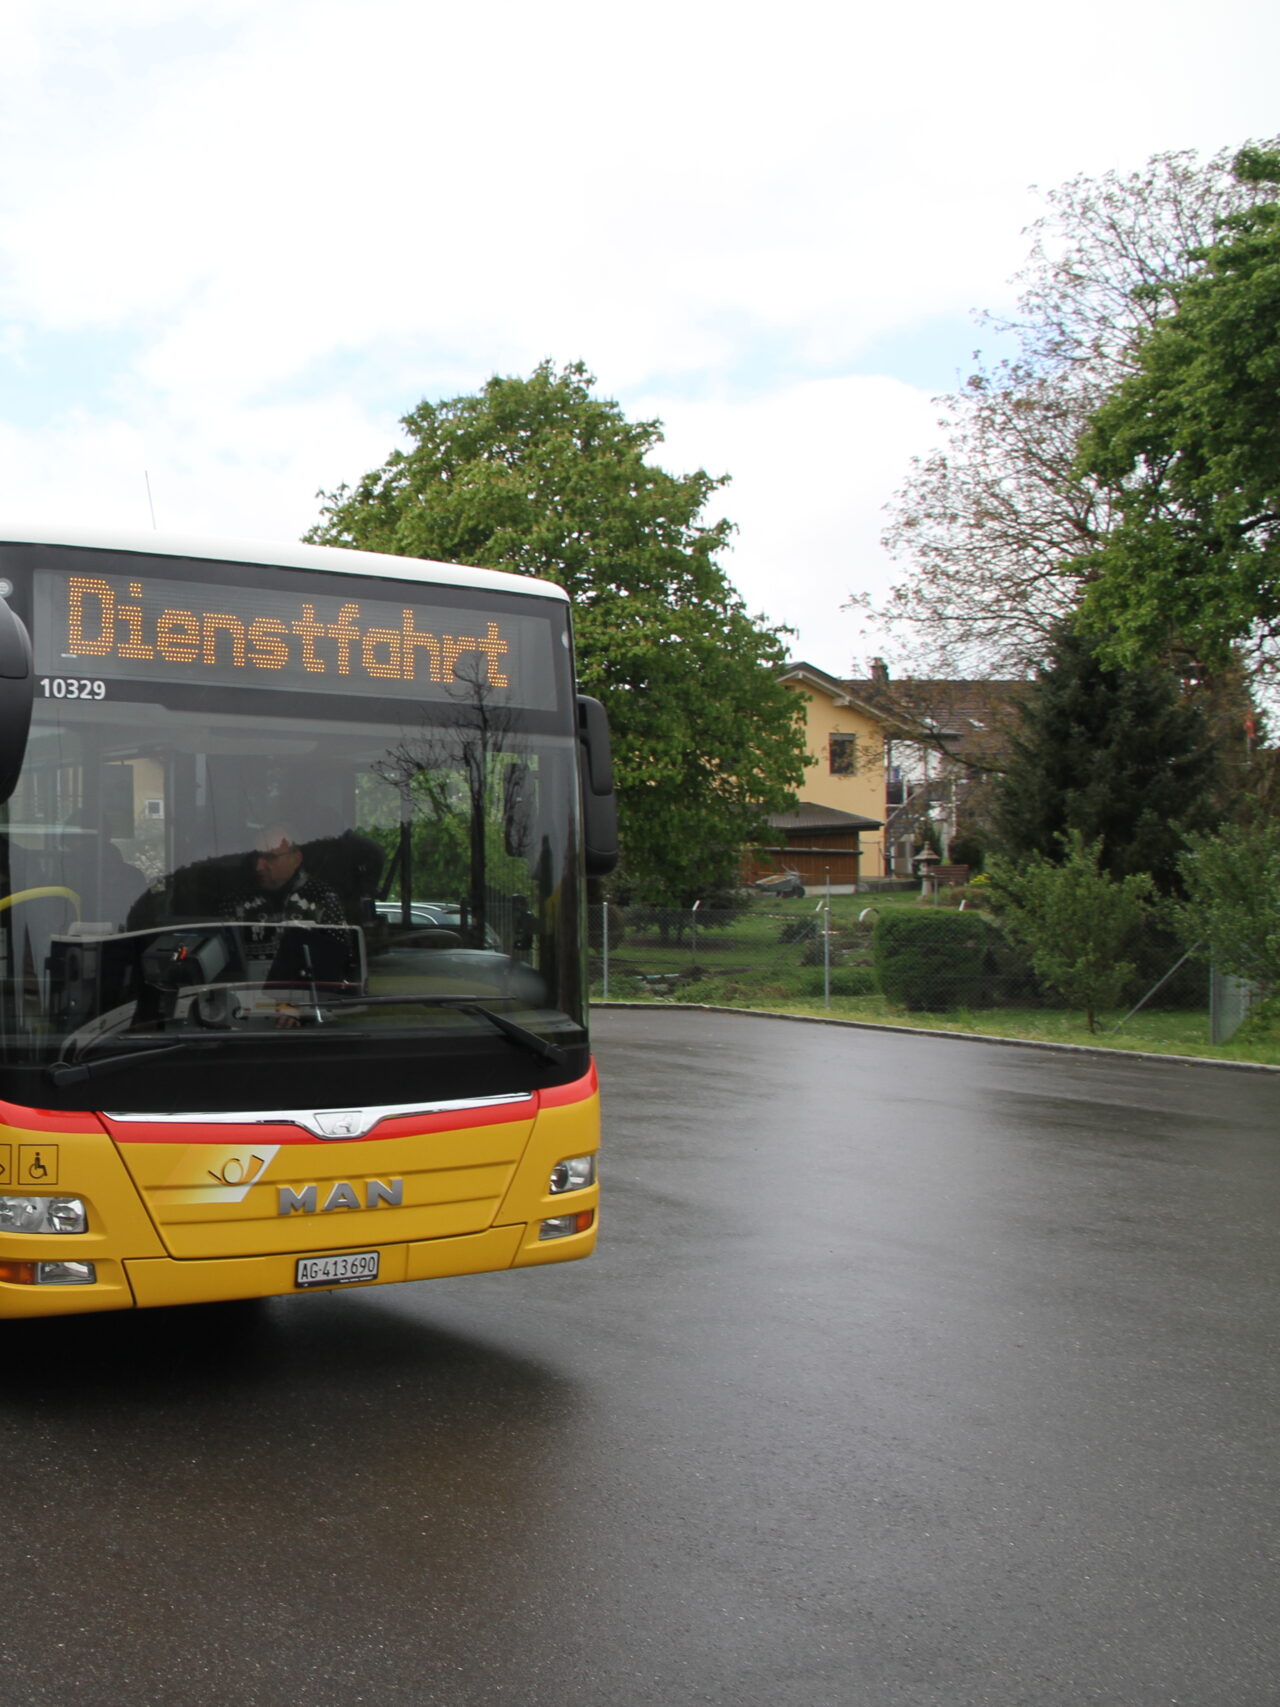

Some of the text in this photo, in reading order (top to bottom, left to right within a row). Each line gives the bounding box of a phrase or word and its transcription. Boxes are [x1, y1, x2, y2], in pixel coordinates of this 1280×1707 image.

[68, 576, 509, 687] Dienstfahrt
[40, 678, 106, 700] 10329
[277, 1177, 403, 1215] MAN
